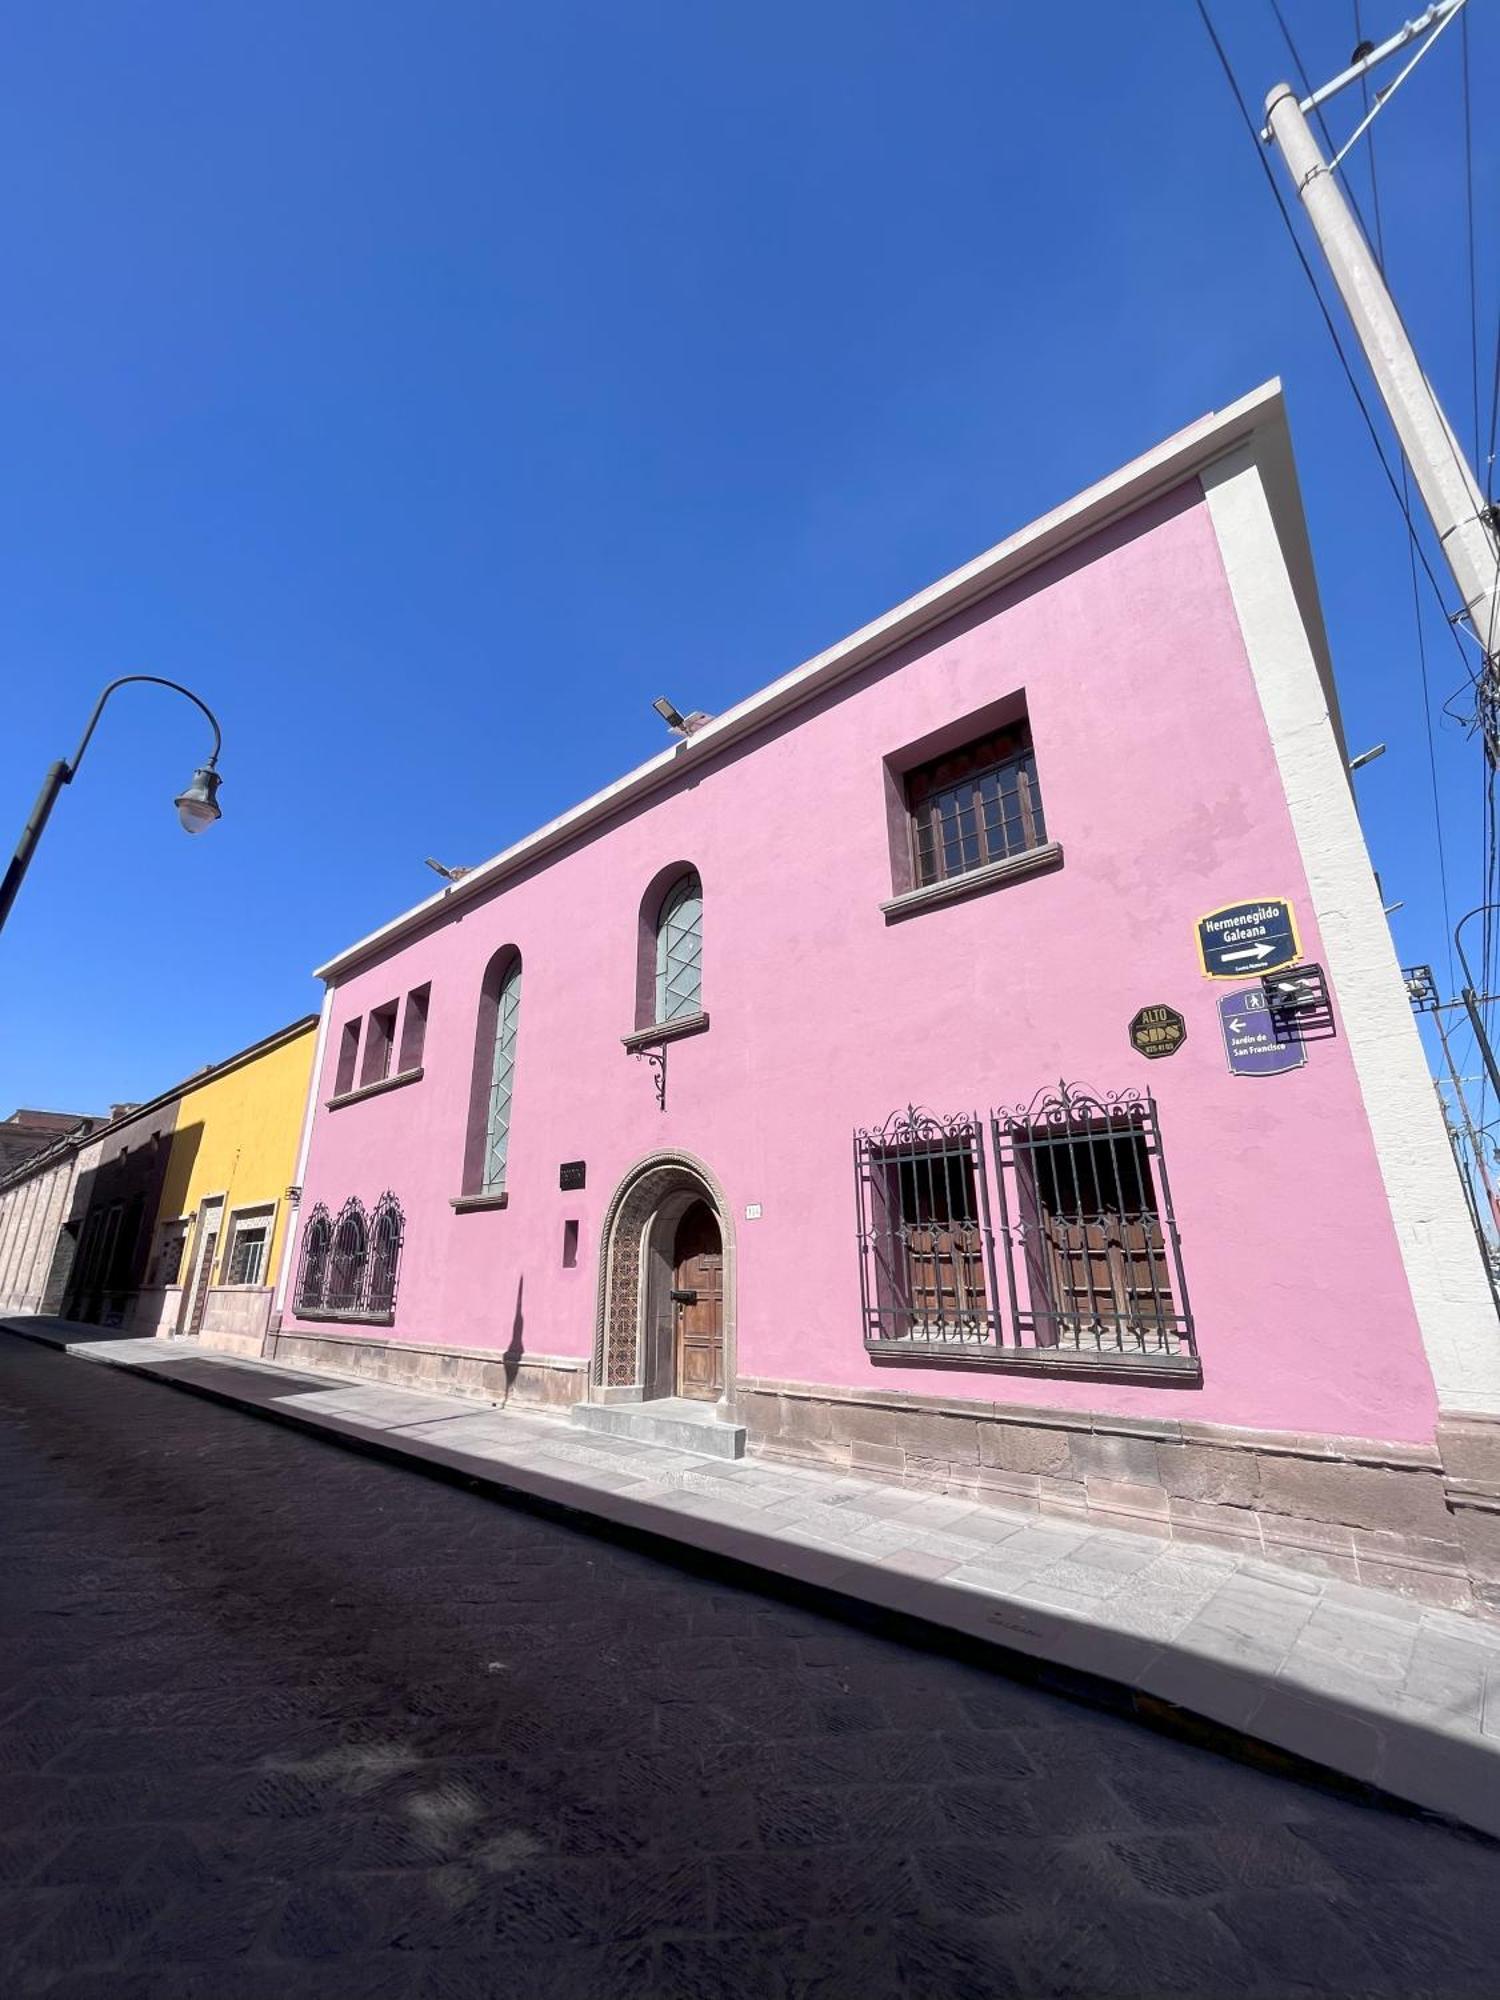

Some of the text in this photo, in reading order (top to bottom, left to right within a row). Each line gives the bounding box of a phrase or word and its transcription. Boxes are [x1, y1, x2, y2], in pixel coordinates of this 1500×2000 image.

[1206, 906, 1280, 933] Hermenegildo
[1223, 926, 1266, 943] Galeana
[1142, 1008, 1167, 1024] ALTO
[1135, 1025, 1180, 1044] SDS
[1256, 1034, 1267, 1042] de
[1233, 1043, 1286, 1057] San Francisco
